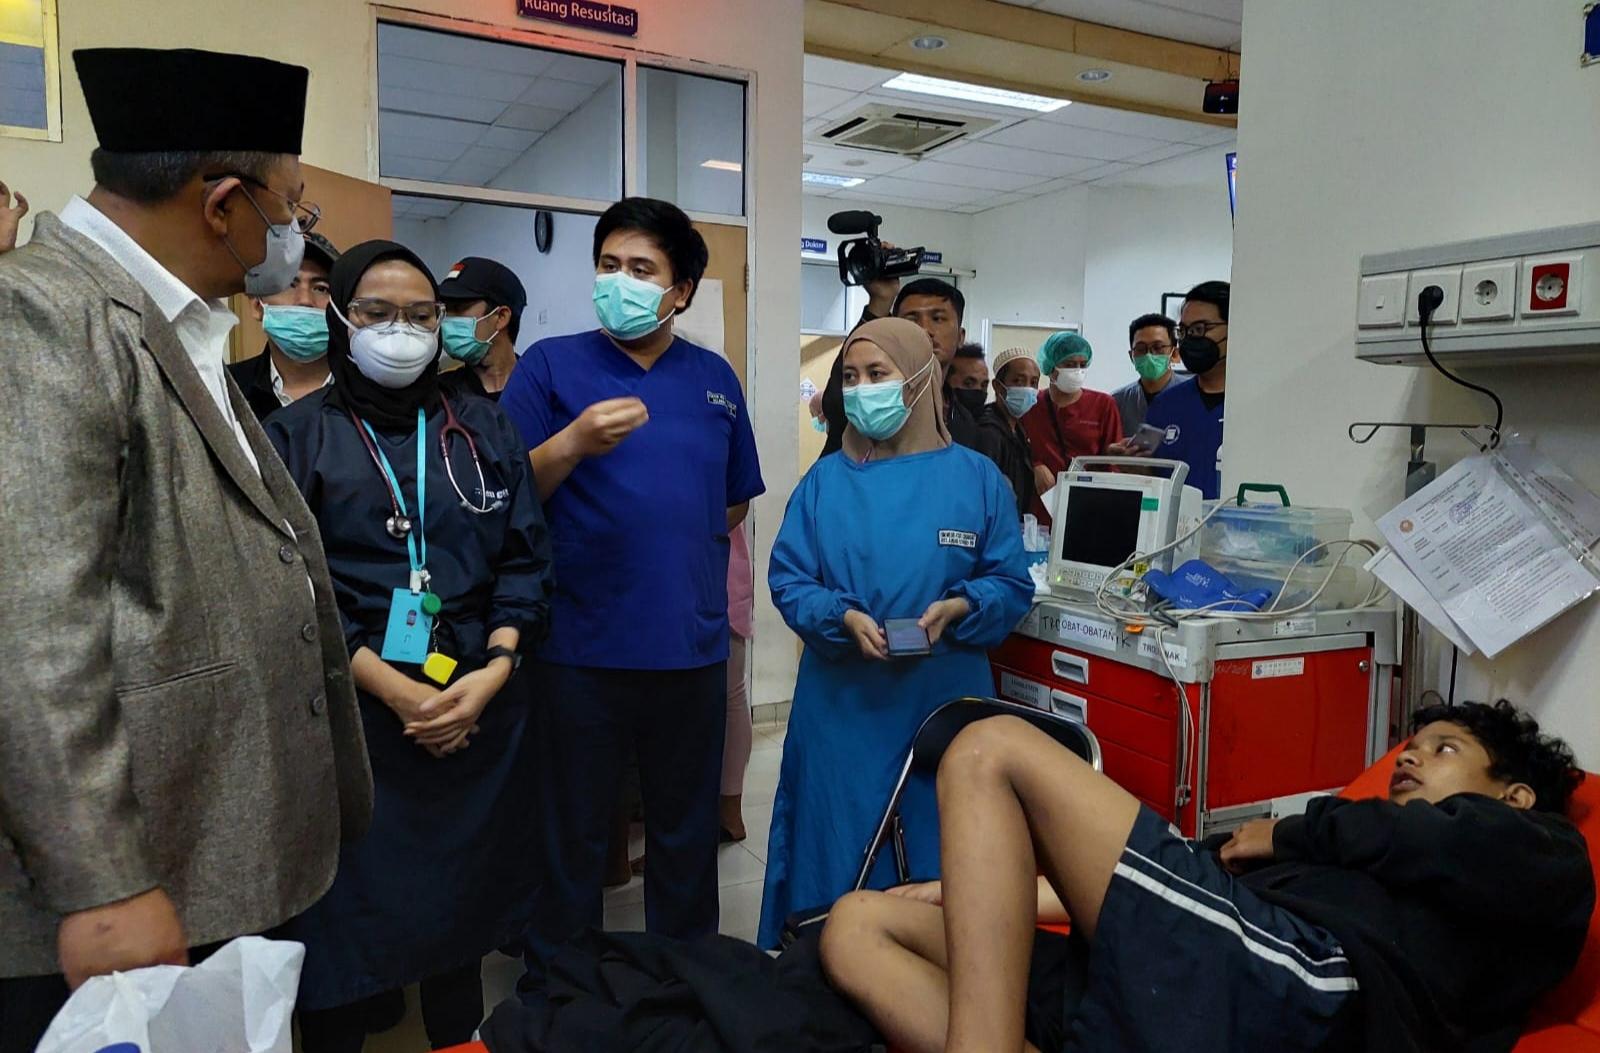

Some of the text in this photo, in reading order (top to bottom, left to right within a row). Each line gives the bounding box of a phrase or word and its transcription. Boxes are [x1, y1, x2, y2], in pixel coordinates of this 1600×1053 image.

[525, 0, 634, 27] Ruang Resusitasi
[1061, 619, 1115, 641] OBAT-OBATAN
